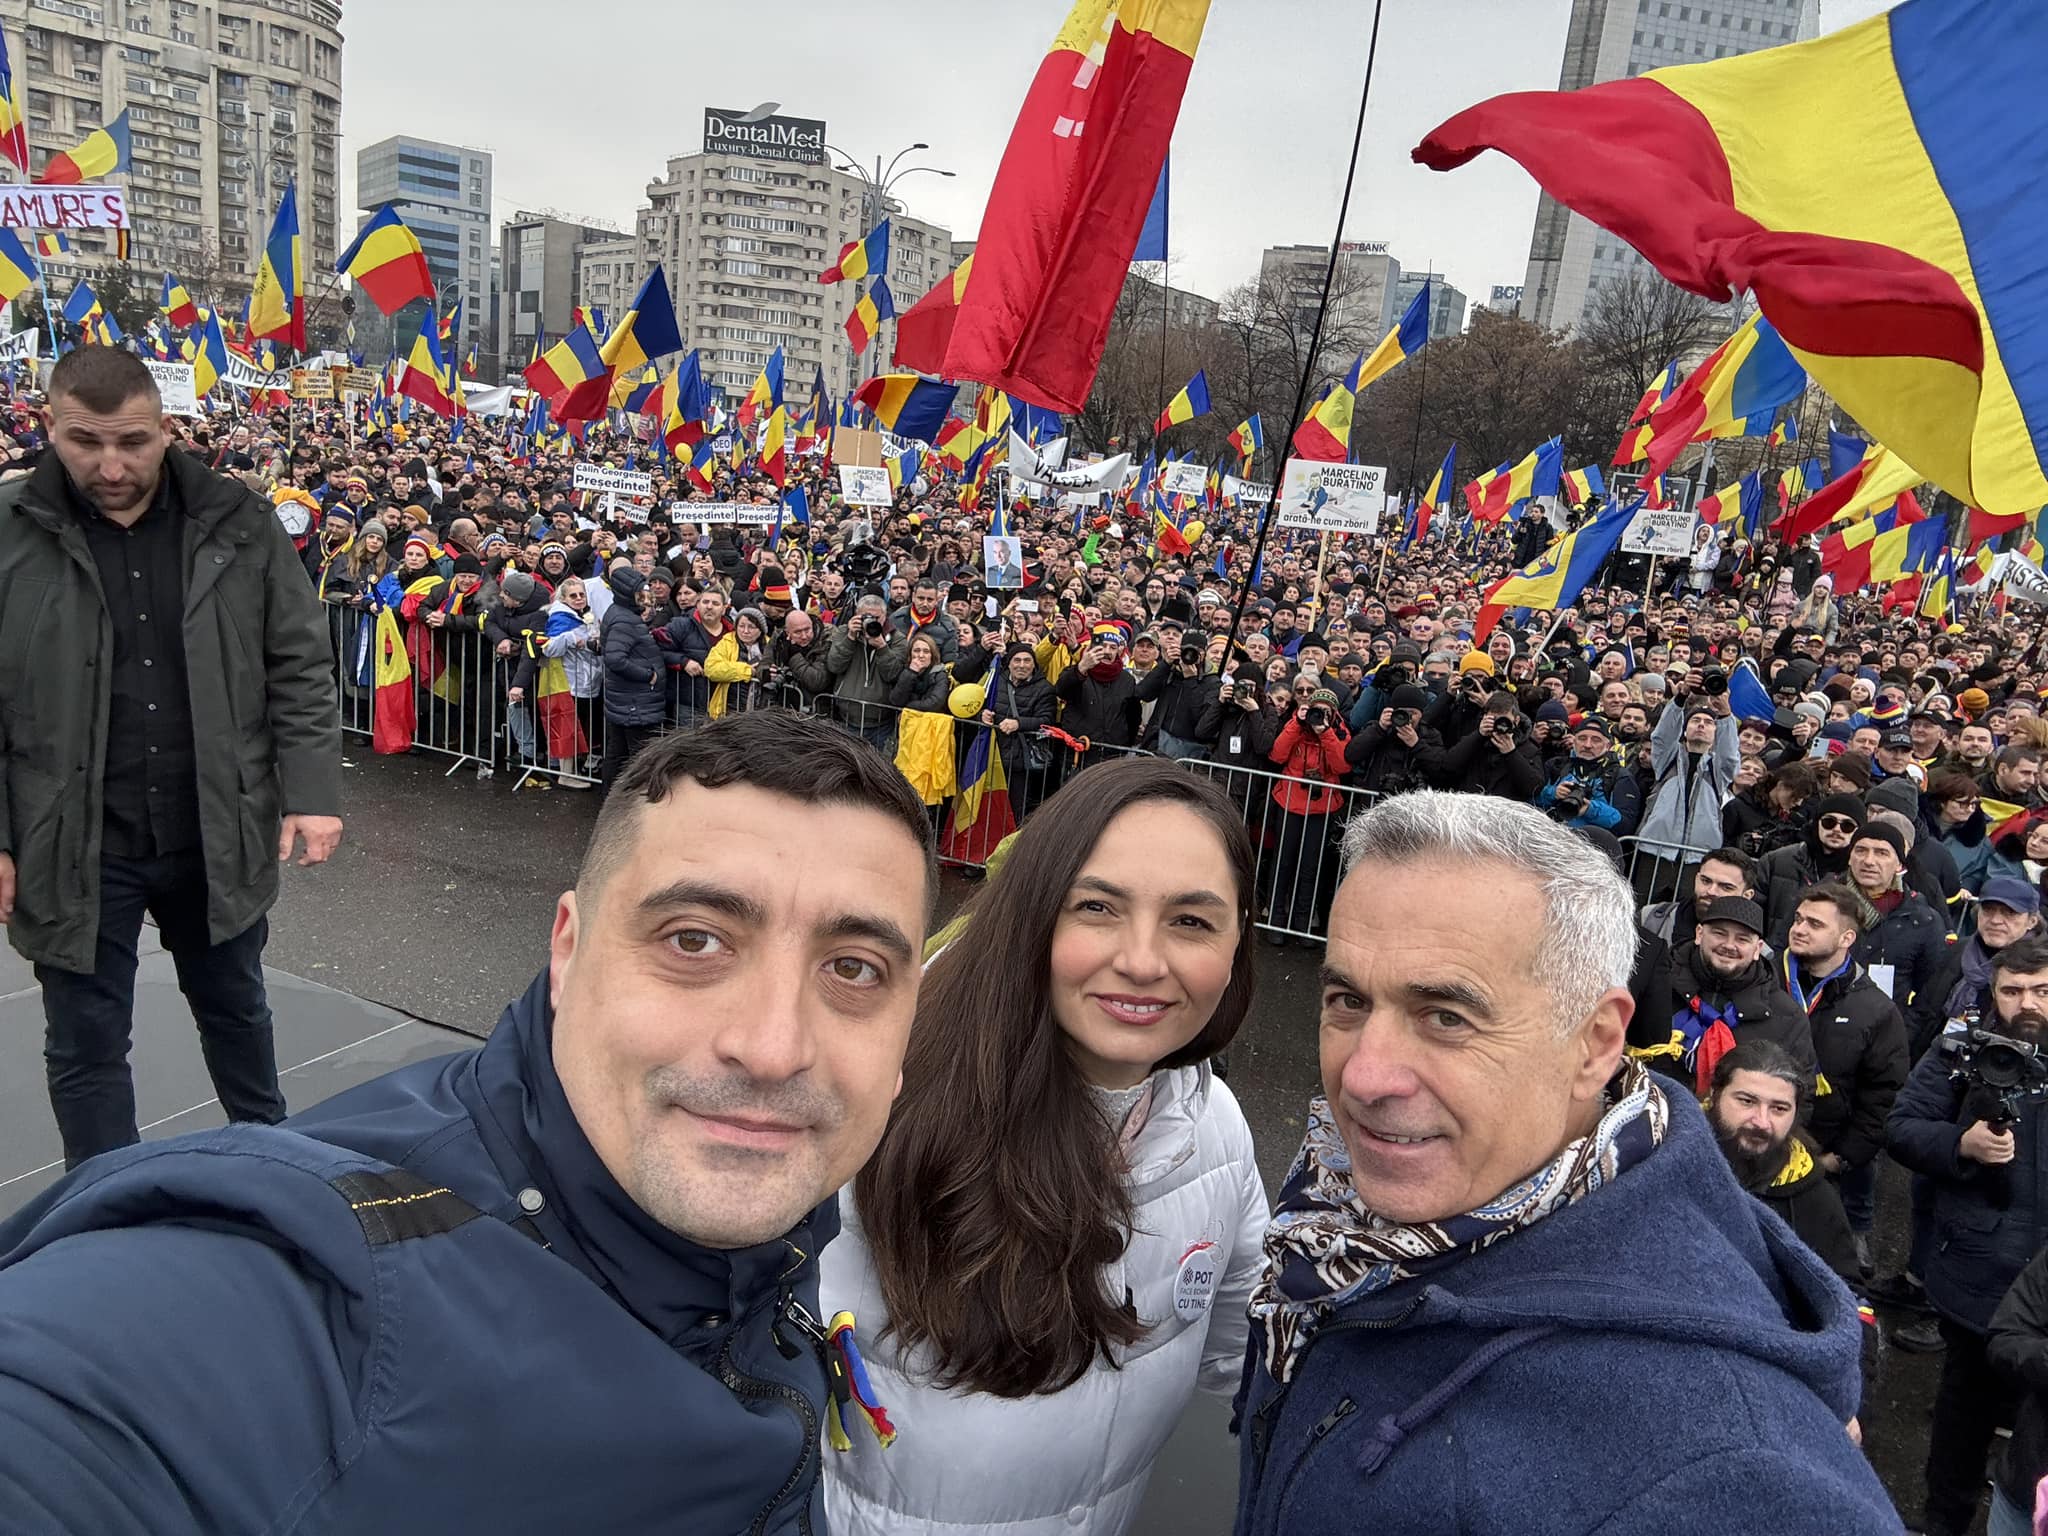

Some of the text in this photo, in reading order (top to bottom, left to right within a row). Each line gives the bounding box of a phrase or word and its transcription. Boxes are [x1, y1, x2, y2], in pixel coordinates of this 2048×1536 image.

[706, 117, 822, 148] DentalMed
[788, 149, 822, 162] Clinic
[1493, 285, 1524, 300] BCR
[148, 365, 190, 376] ARCELINO
[601, 467, 650, 480] Georgescu
[1320, 466, 1379, 482] MARCELINO
[1239, 481, 1273, 499] COVA
[1322, 477, 1374, 491] BURATINO
[1323, 516, 1342, 526] cum
[1343, 518, 1369, 530] zbori!
[1193, 1271, 1213, 1285] POT
[1178, 1298, 1190, 1309] CU
